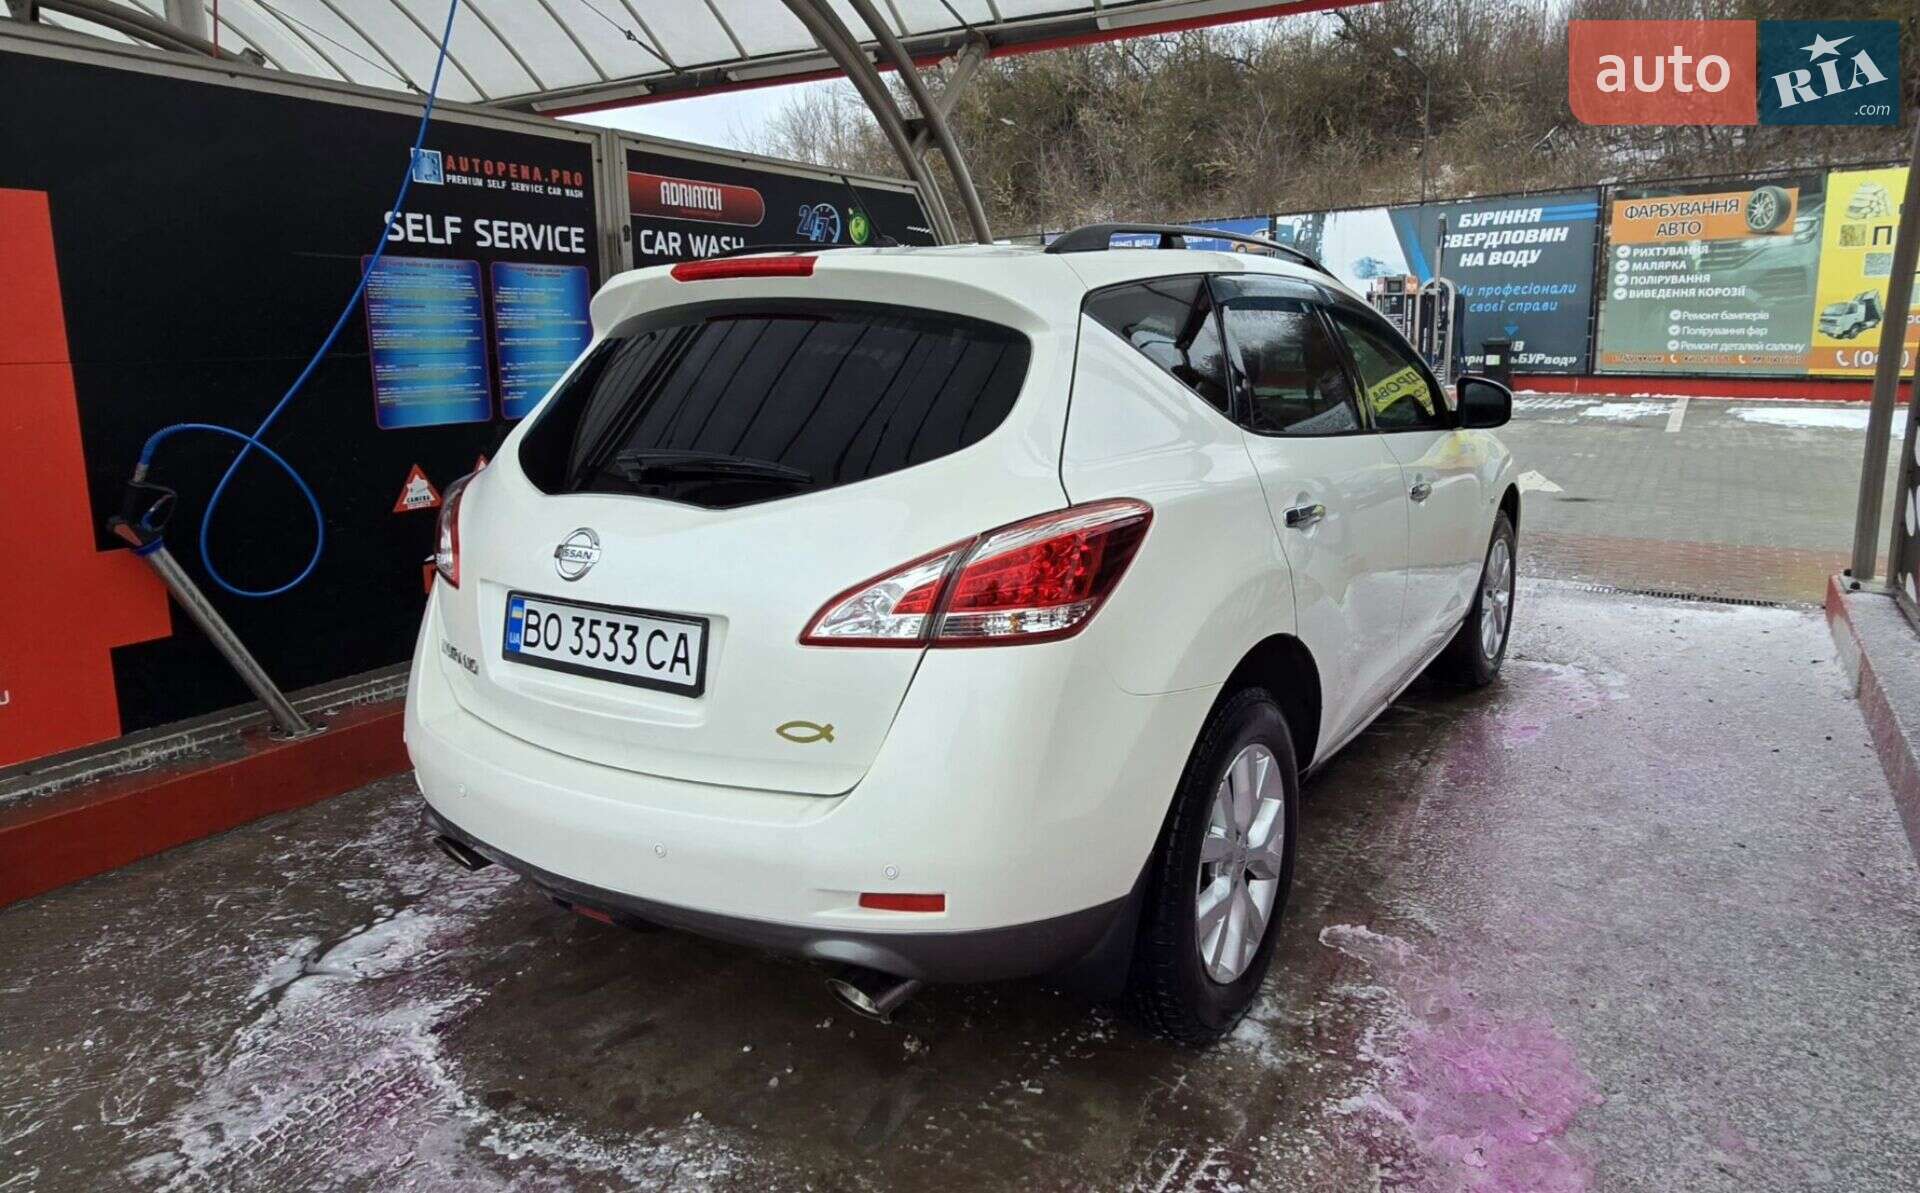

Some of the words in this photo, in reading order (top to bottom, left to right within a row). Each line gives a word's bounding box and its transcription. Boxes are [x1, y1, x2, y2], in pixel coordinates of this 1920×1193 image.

[446, 174, 483, 187] PREMIUM
[487, 179, 507, 190] SELF
[511, 182, 544, 194] SERVICE
[547, 187, 562, 196] CAR
[565, 189, 584, 198] WASH
[1625, 198, 1739, 219] ФАРБУВАННЯ
[1458, 208, 1544, 228] БУРІННЯ
[384, 211, 462, 246] SELF
[474, 219, 587, 254] SERVICE
[1656, 221, 1702, 237] АВТО
[640, 230, 682, 256] CAR
[1632, 245, 1709, 258] РИХТУВАННЯ
[1459, 251, 1484, 267] НА
[1488, 249, 1542, 268] ВОДУ
[1632, 260, 1687, 272] МАЛЯРКА
[1630, 274, 1711, 286] ПОЛІРУВАННЯ
[1477, 282, 1577, 298] професіонали
[1629, 288, 1696, 300] ВИВЕДЕННЯ
[1507, 301, 1559, 314] справи
[1682, 311, 1718, 321] Ремонт
[1746, 326, 1769, 337] фар
[1680, 341, 1719, 351] Ремонт
[556, 548, 593, 560] ISSAN
[509, 632, 521, 645] UA
[523, 609, 562, 651] BO
[569, 616, 639, 665] 3533
[646, 629, 691, 676] CA
